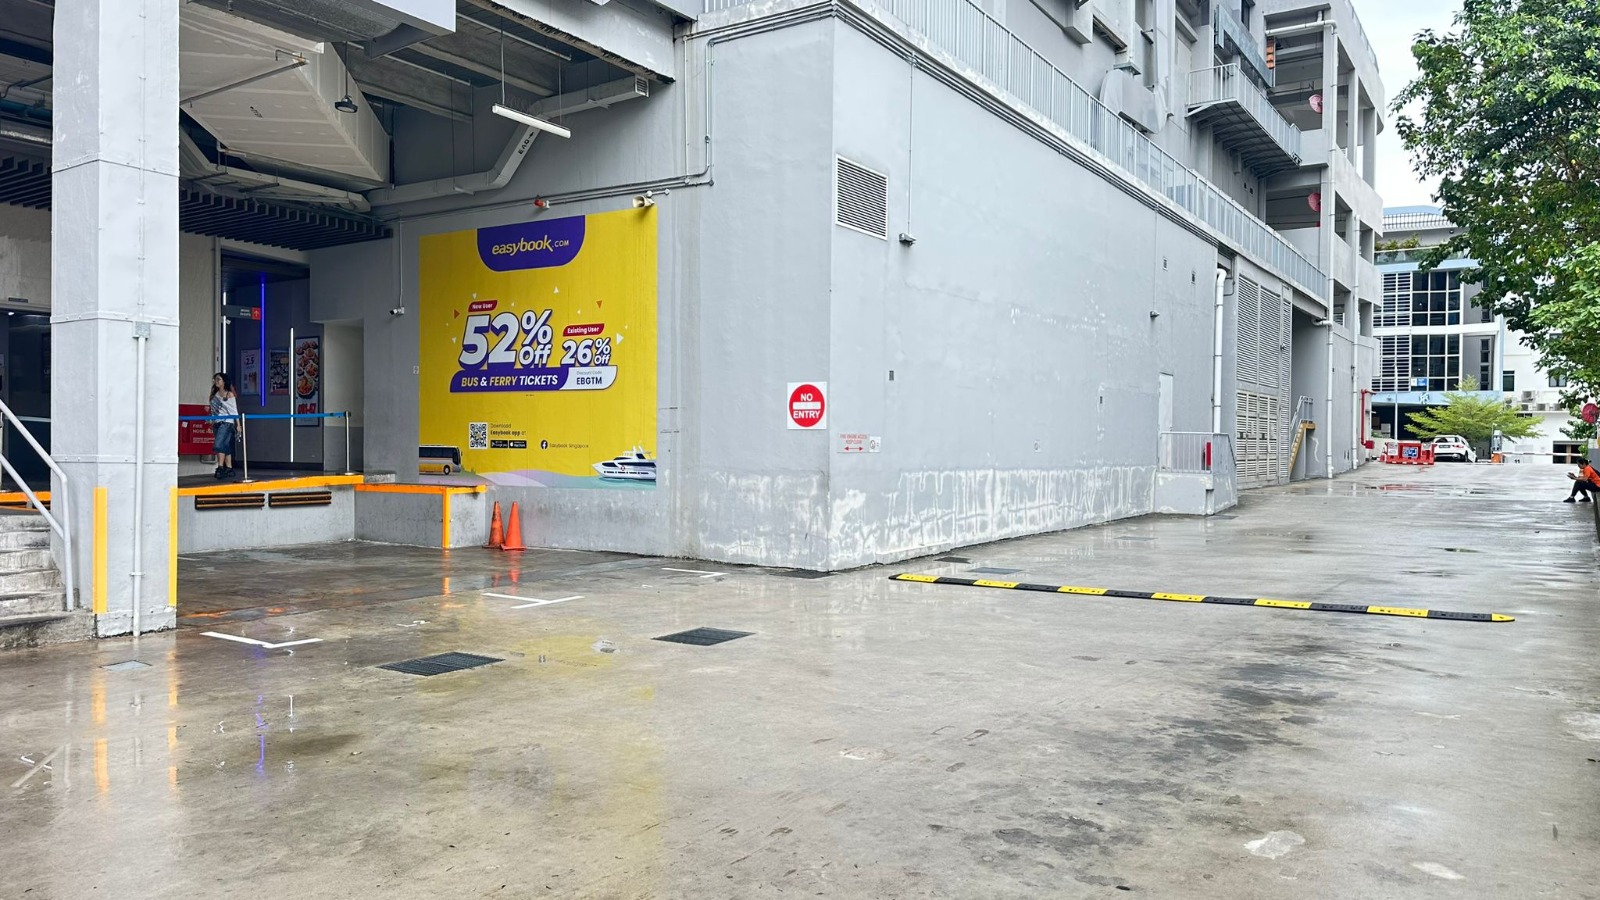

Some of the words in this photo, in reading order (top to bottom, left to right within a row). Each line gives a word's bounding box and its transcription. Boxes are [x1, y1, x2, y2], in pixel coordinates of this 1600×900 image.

[567, 327, 587, 335] Existing
[461, 377, 479, 387] BUS
[480, 376, 488, 386] &
[489, 375, 518, 386] FERRY
[519, 374, 559, 386] TICKETS
[576, 376, 603, 385] EBGTM
[801, 393, 813, 401] NO
